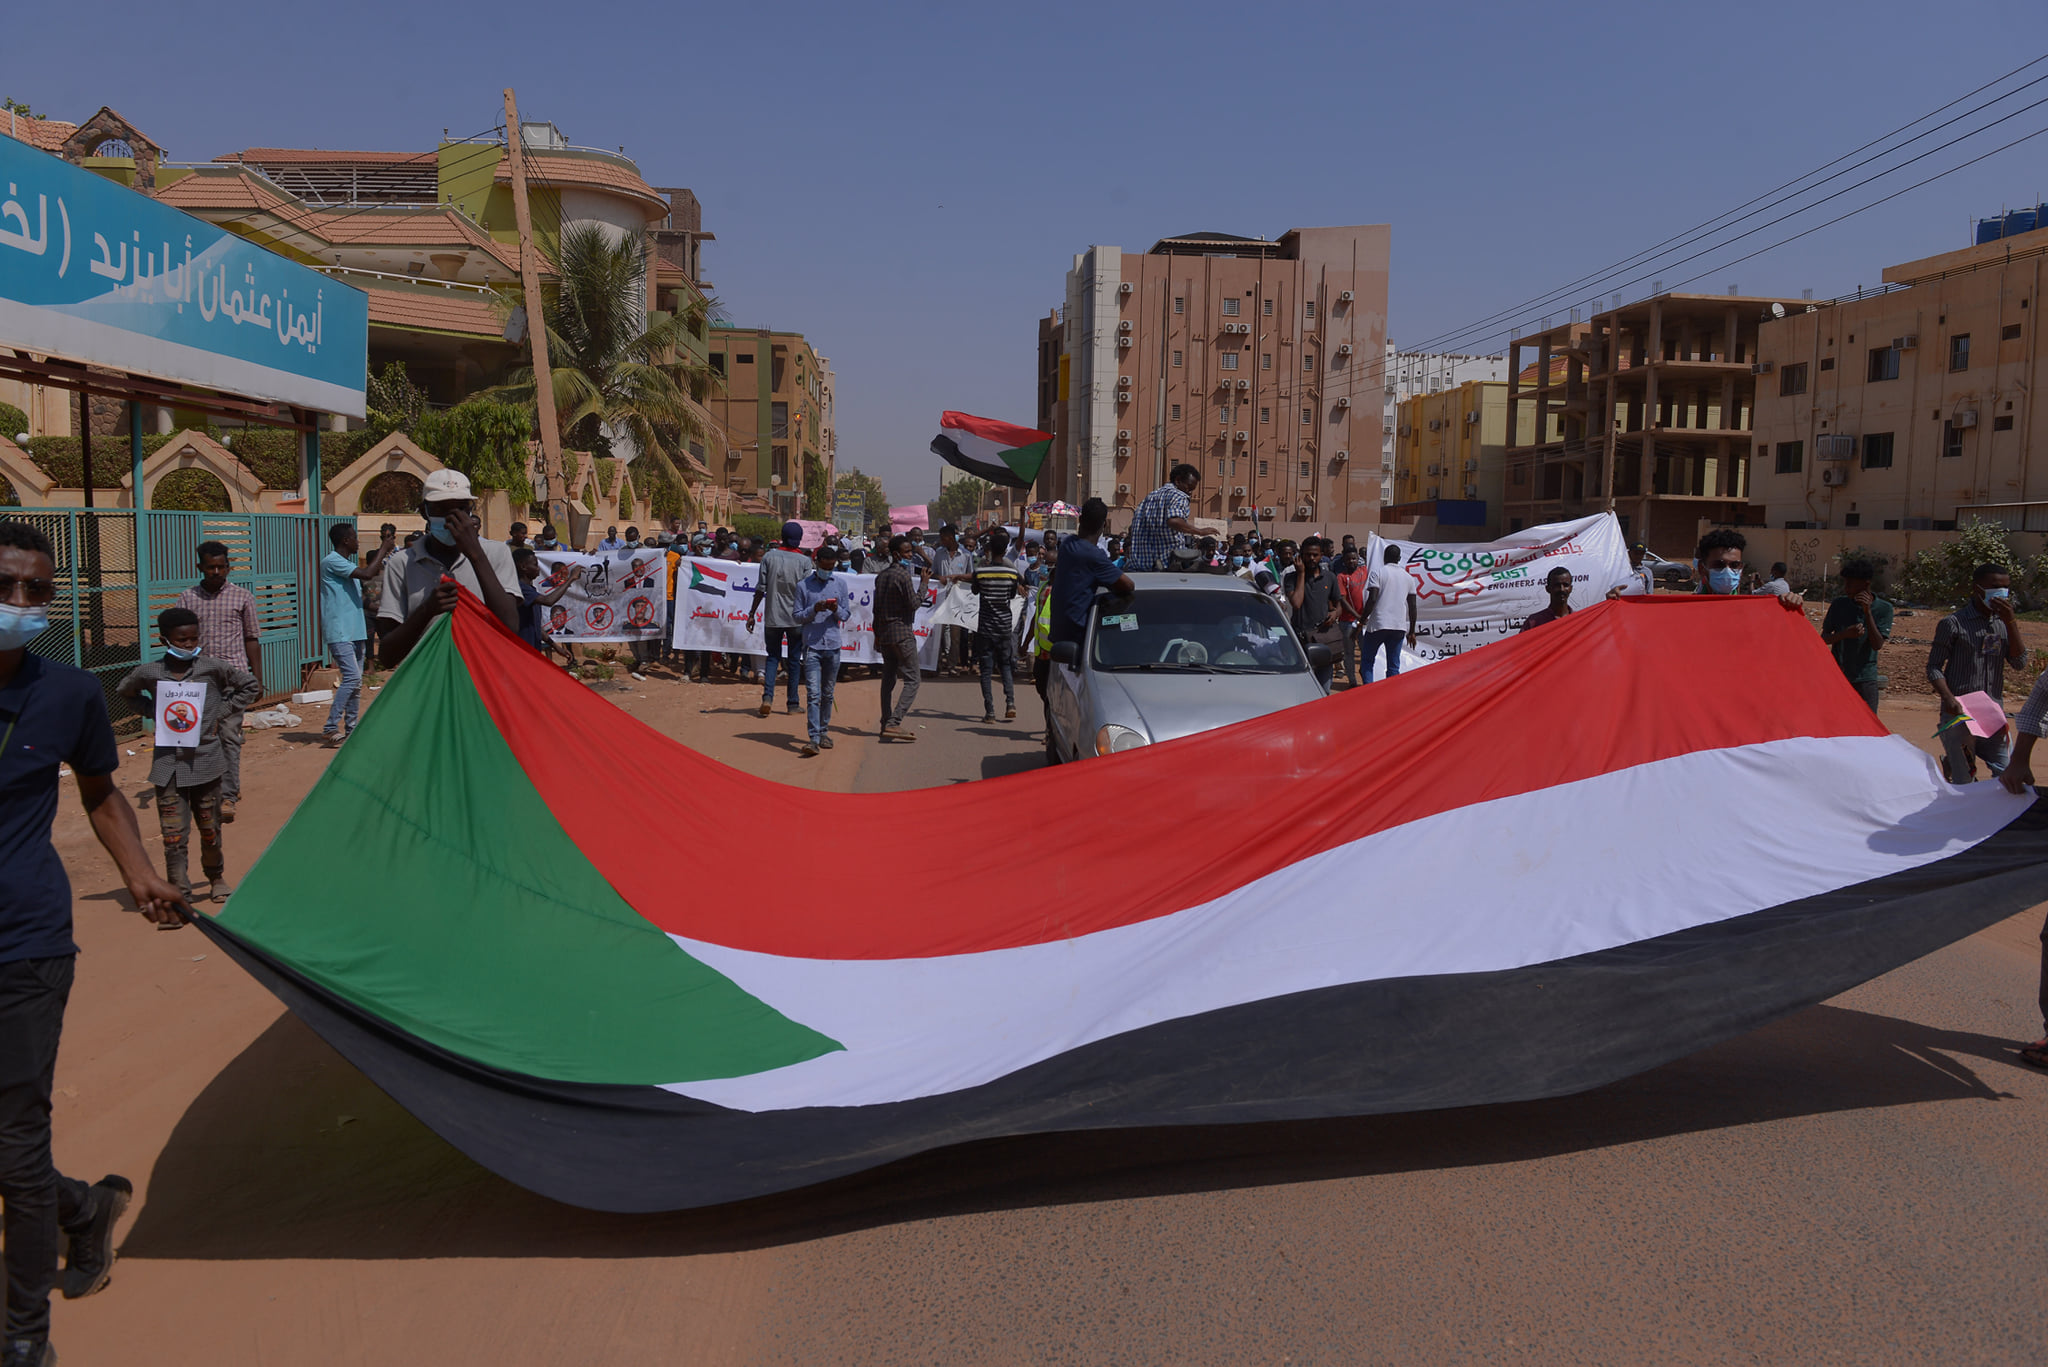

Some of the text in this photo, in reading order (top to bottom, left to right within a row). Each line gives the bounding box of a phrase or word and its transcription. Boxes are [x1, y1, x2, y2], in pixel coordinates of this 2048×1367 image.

[90, 230, 154, 305] يزيد
[163, 234, 193, 314] أبا
[198, 258, 272, 329] عثمان
[276, 288, 323, 354] أيمن
[1487, 574, 1590, 591] ENGINEERS ASTION
[1491, 566, 1529, 582] SUST
[690, 606, 724, 620] العسكر
[1415, 620, 1490, 638] الديمقراط
